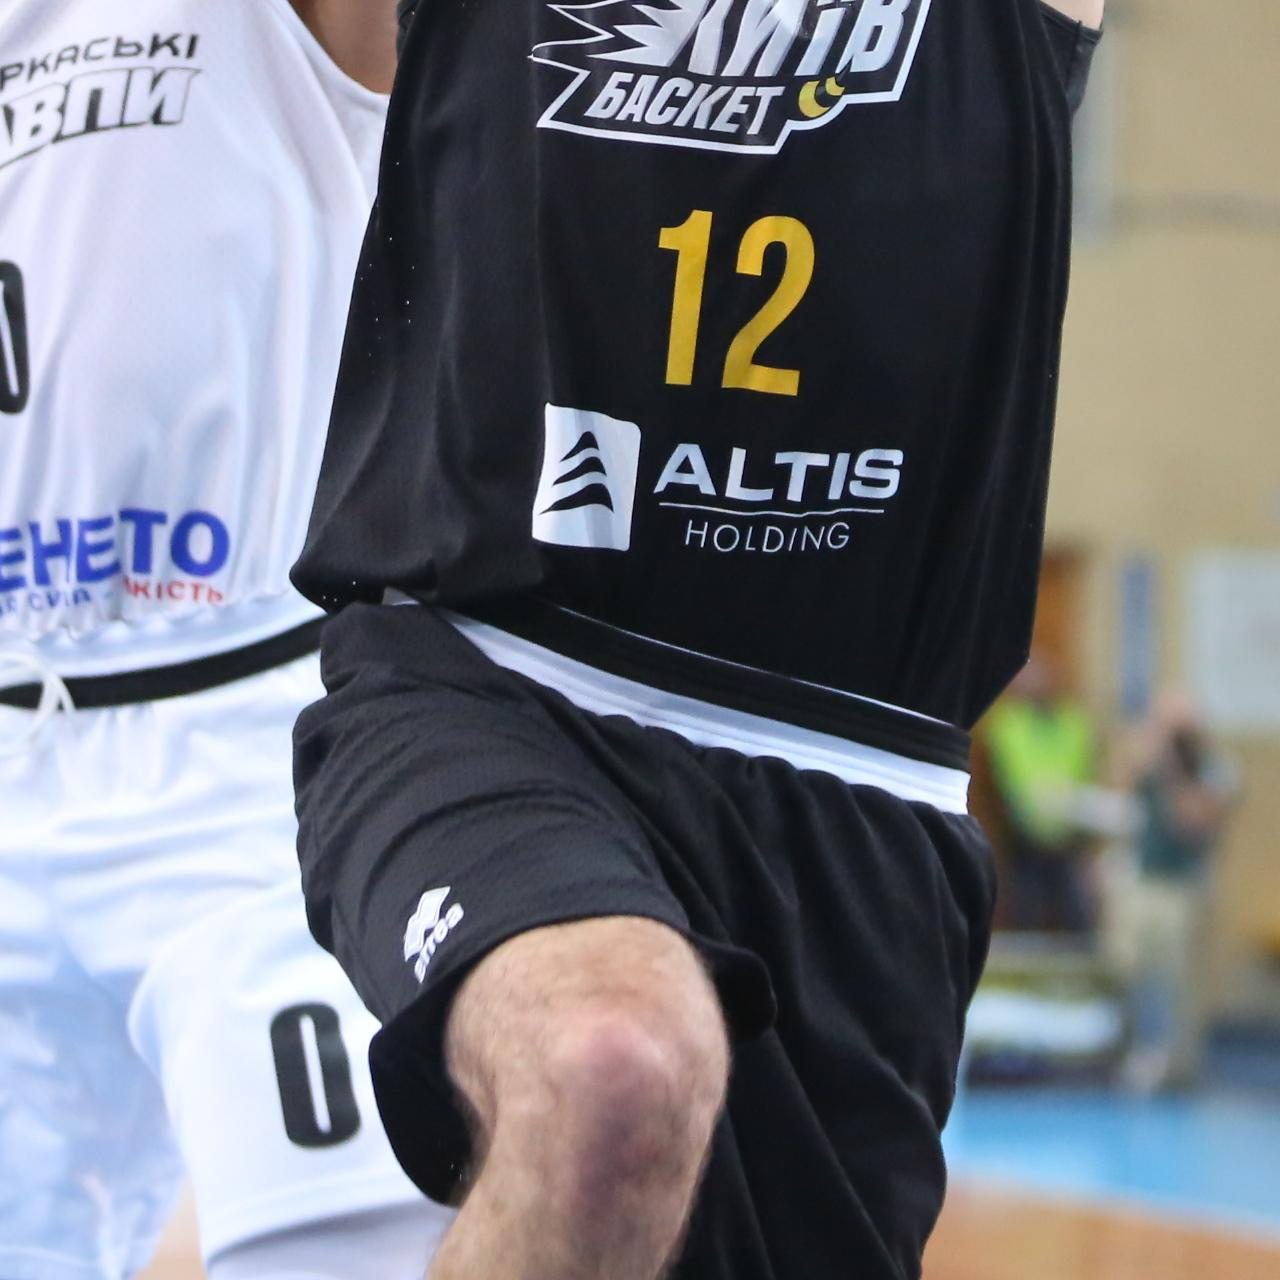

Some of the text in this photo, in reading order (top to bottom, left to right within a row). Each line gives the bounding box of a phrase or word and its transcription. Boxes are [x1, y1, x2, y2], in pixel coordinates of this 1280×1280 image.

[586, 71, 785, 136] БАСКЕТ
[657, 209, 815, 396] 12
[653, 443, 904, 503] ALTIS
[685, 519, 851, 554] HOLDING
[269, 1001, 362, 1150] 0
